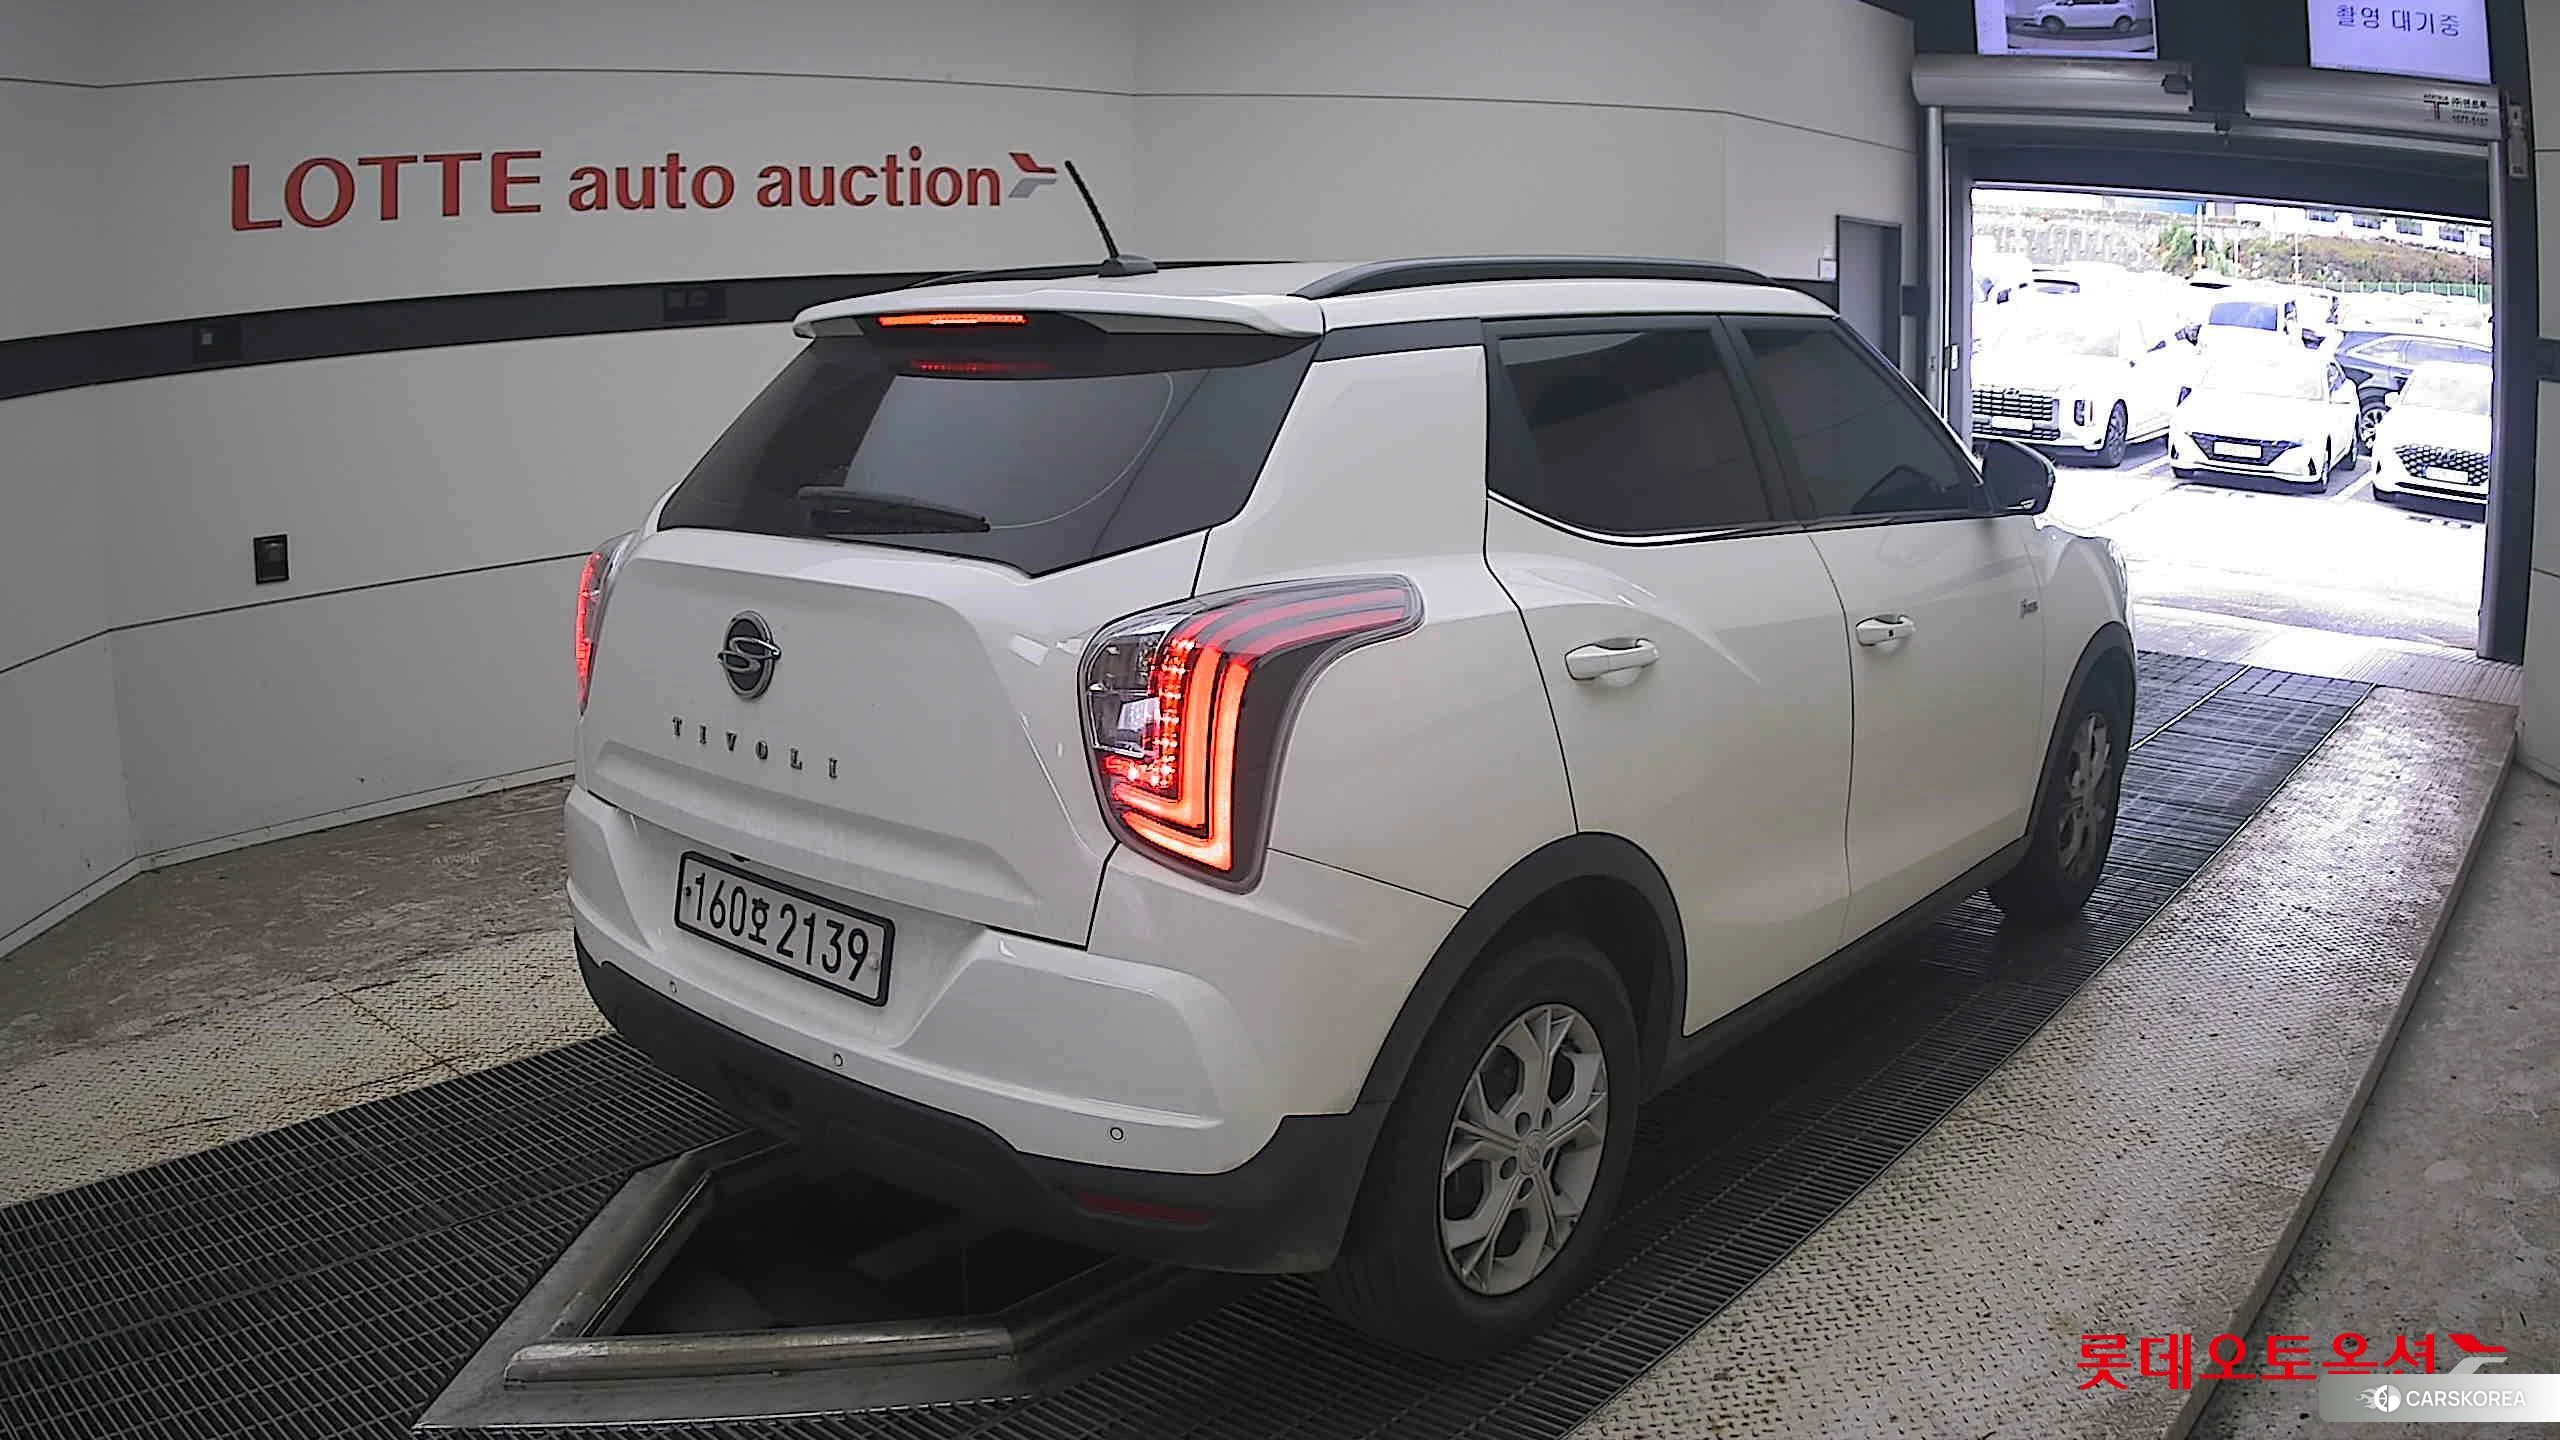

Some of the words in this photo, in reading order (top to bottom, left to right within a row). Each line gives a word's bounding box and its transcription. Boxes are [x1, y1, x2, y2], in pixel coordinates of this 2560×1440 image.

[2391, 8, 2460, 37] 대기중
[231, 150, 542, 232] LOTTE
[568, 152, 736, 212] auto
[755, 145, 1001, 208] auction
[671, 716, 840, 780] TIVOLI
[695, 872, 869, 982] 160호2139
